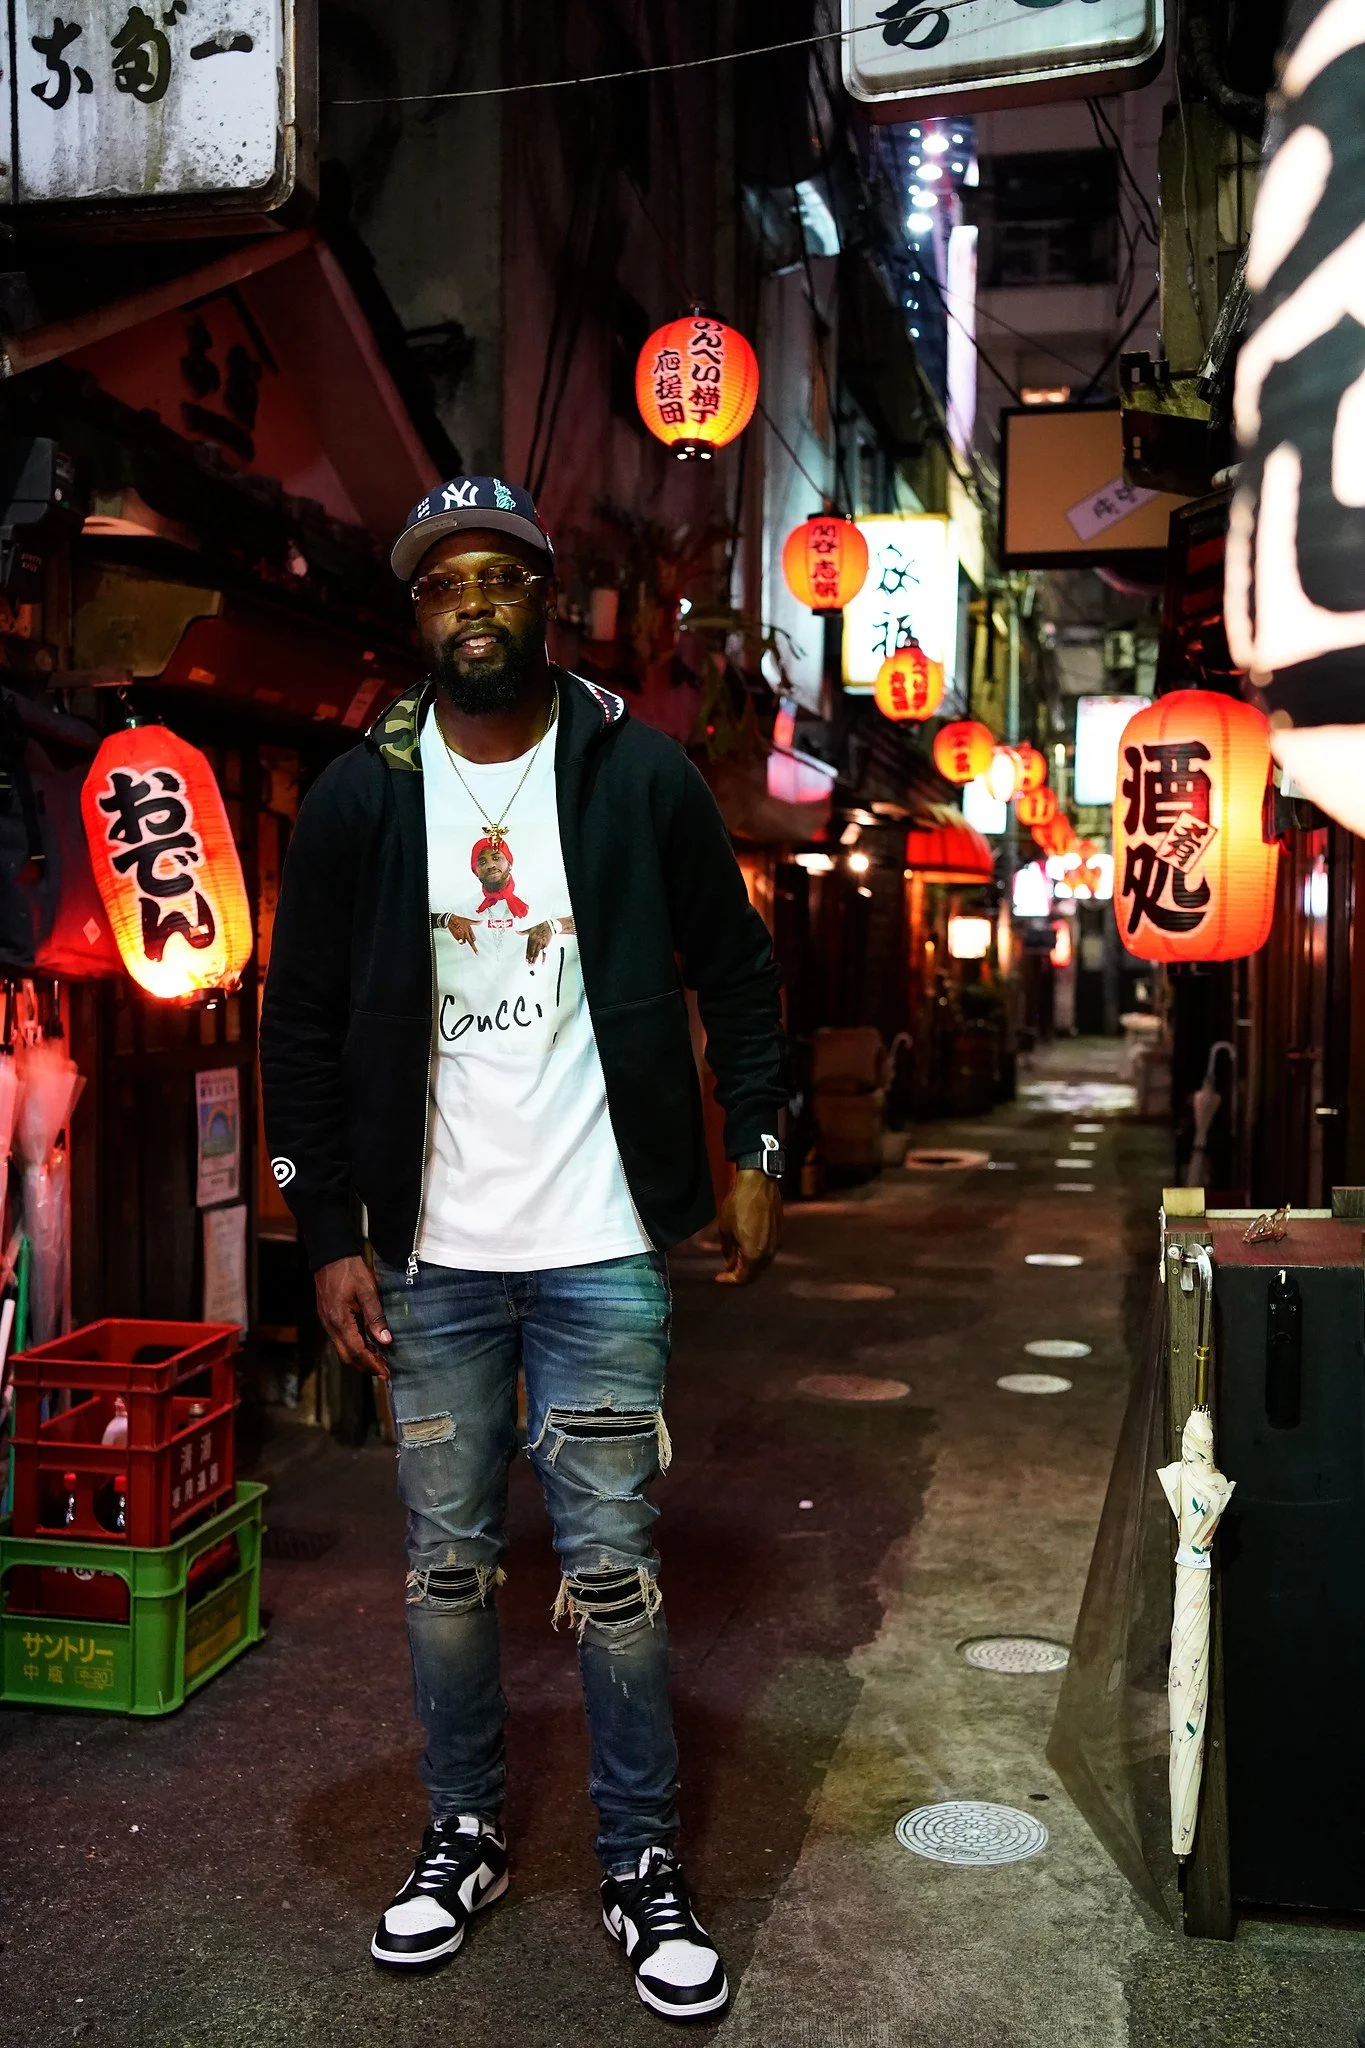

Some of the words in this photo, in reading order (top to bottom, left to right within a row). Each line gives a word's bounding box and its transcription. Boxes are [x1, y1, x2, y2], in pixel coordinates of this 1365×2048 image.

[653, 349, 686, 425] 応援団
[441, 480, 480, 510] NY
[99, 771, 216, 963] おでん
[22, 1631, 114, 1664] サントリー
